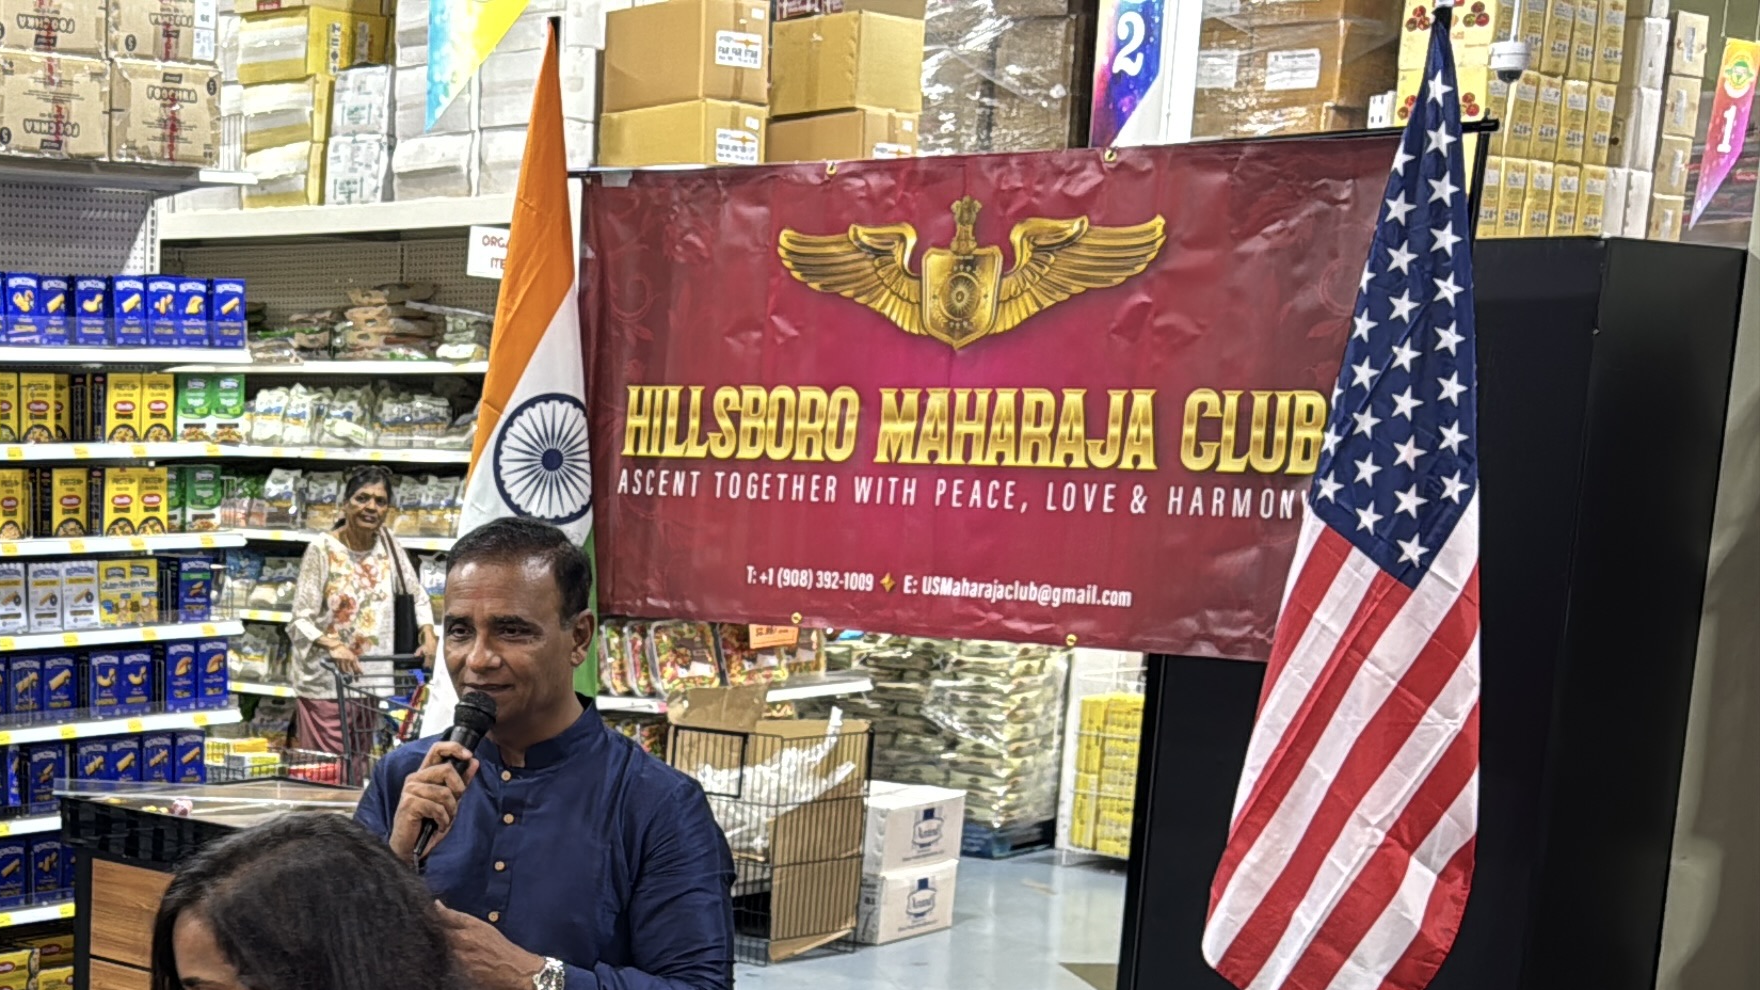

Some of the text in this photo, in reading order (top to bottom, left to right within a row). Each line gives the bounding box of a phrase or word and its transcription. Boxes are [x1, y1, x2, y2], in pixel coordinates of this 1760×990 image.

[1113, 11, 1146, 76] 2
[1716, 105, 1737, 153] 1
[482, 235, 508, 248] ORG
[621, 385, 1327, 474] HILLSBORO MAHARAJA CLUB
[617, 468, 701, 498] ASCENT
[714, 471, 838, 503] TOGETHER
[853, 475, 917, 506] WITH
[935, 477, 1028, 513] PEACE,
[1046, 481, 1116, 513] LOVE
[1130, 485, 1148, 515] &
[746, 564, 1133, 608] T: +1 (908) 392-1009 E: USMaharajaclub@gmail.com
